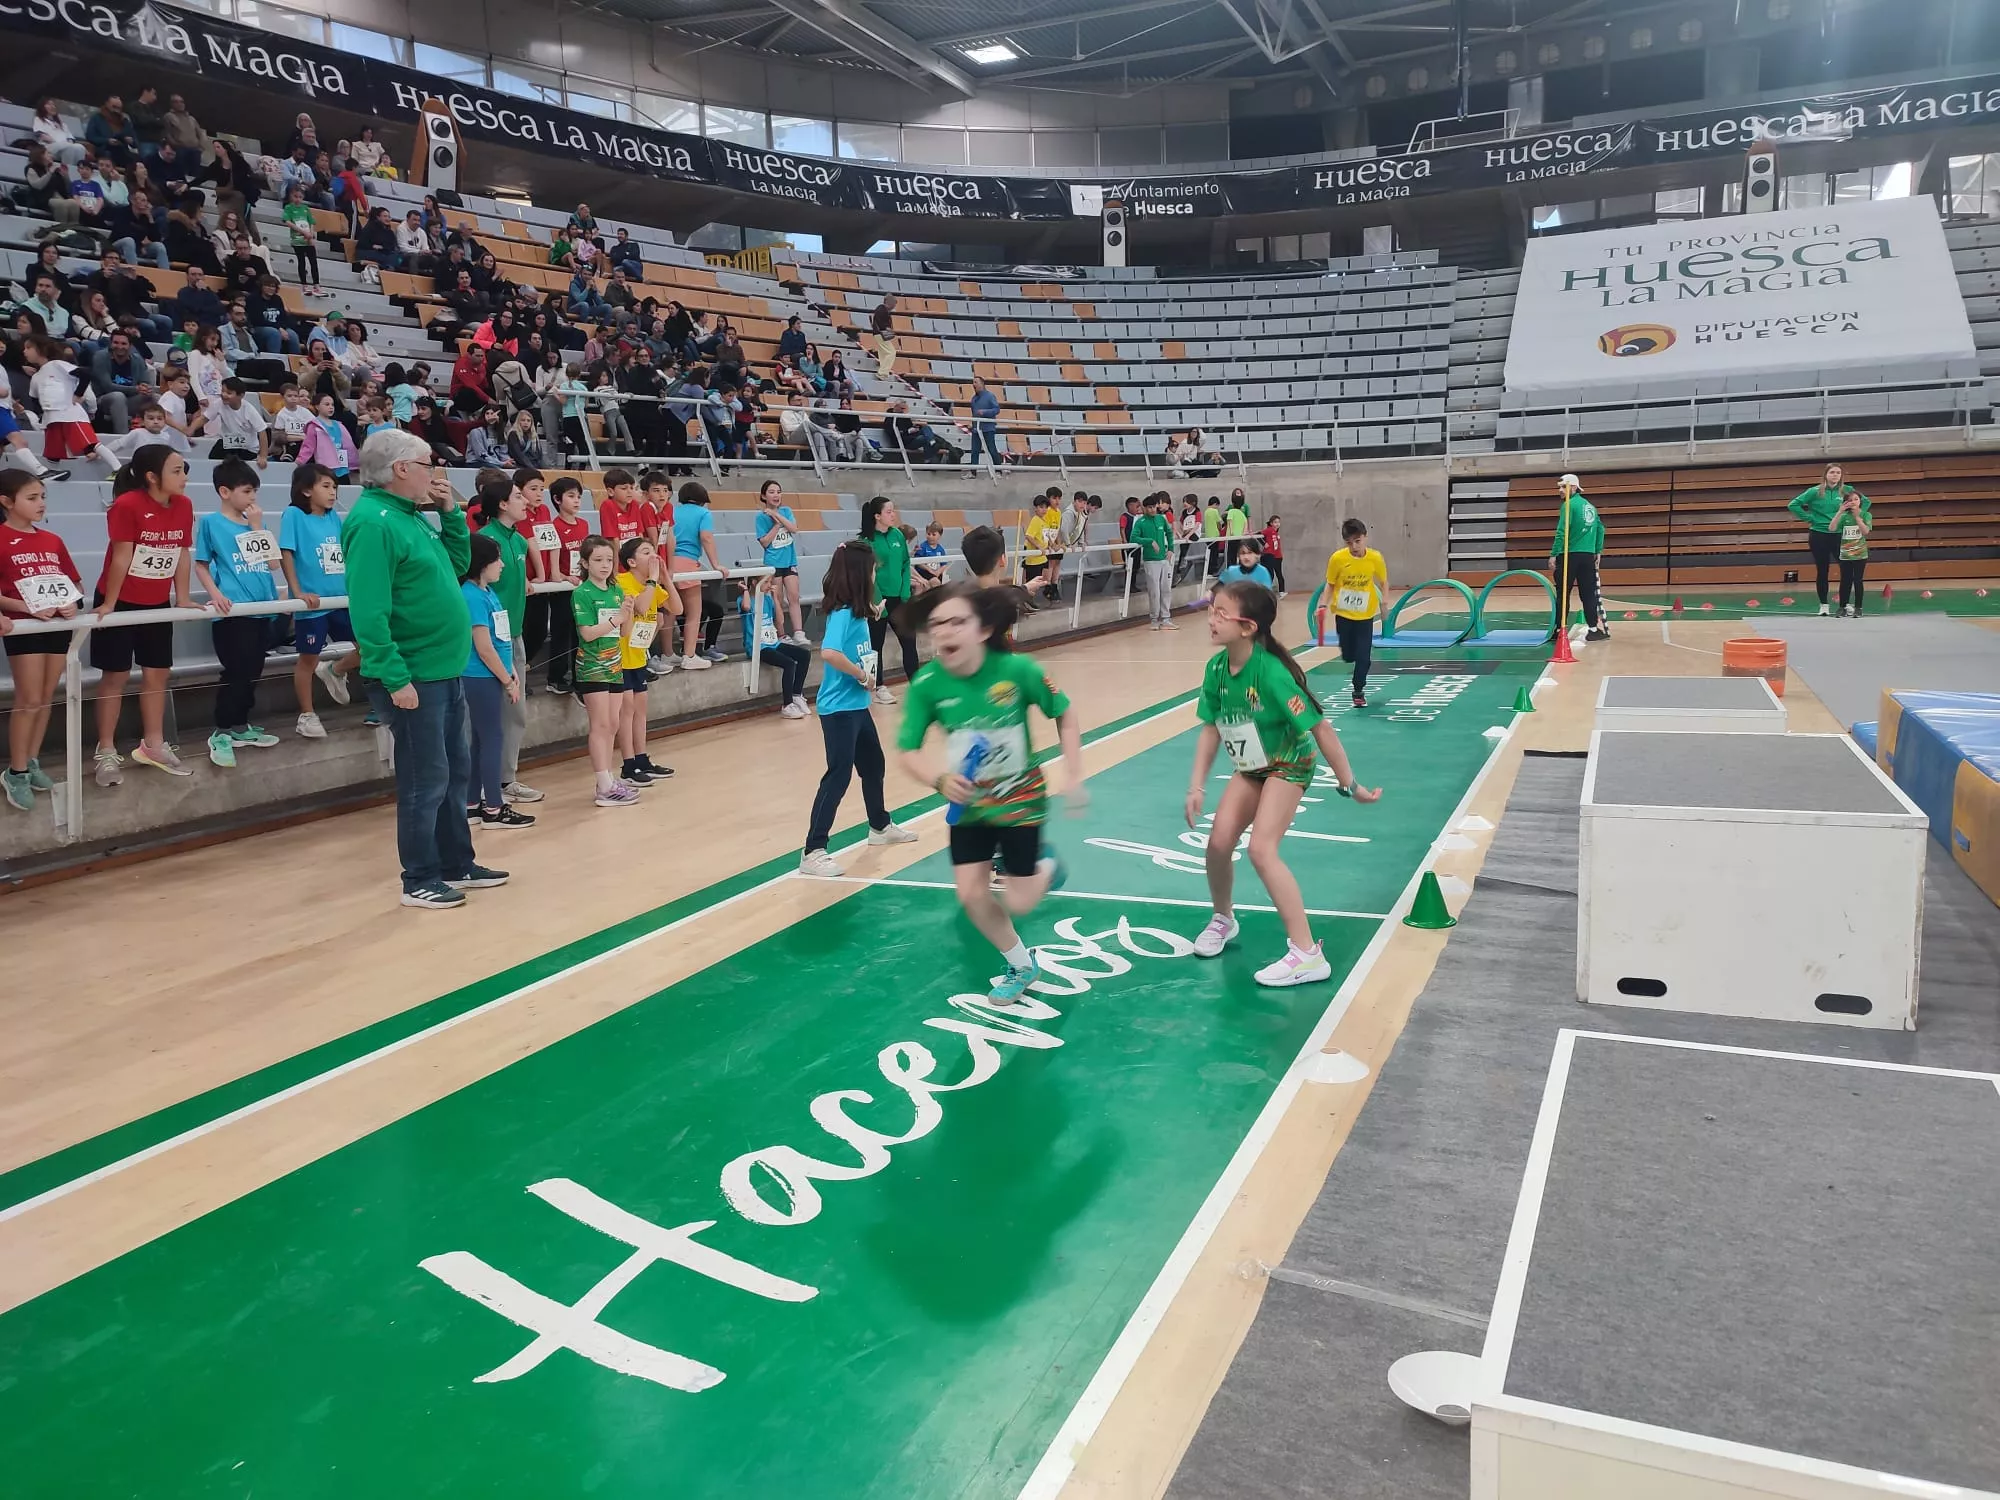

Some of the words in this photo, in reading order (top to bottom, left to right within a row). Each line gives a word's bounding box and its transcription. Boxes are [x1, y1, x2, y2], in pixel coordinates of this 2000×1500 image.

[391, 81, 543, 142] Hesca
[546, 120, 591, 152] La
[1484, 131, 1613, 168] Huesca
[724, 147, 831, 186] Huesca
[1313, 158, 1433, 190] Huesca
[1506, 168, 1527, 183] La
[750, 179, 769, 193] La
[873, 174, 982, 200] Huesca
[1110, 182, 1219, 202] Ayuntamiento
[1135, 200, 1194, 216] Huesca
[1337, 190, 1356, 205] La
[1559, 235, 1900, 292] Huesca
[1600, 283, 1656, 308] La
[1695, 312, 1859, 333] DIPUTACIÓN
[1695, 322, 1861, 344] HUESCA
[246, 538, 271, 554] 408
[142, 556, 174, 570] 438
[330, 551, 345, 565] 40
[37, 582, 69, 598] 445
[1385, 674, 1481, 706] Huesca
[1224, 739, 1247, 758] 87
[416, 914, 1196, 1394] Hacemos
